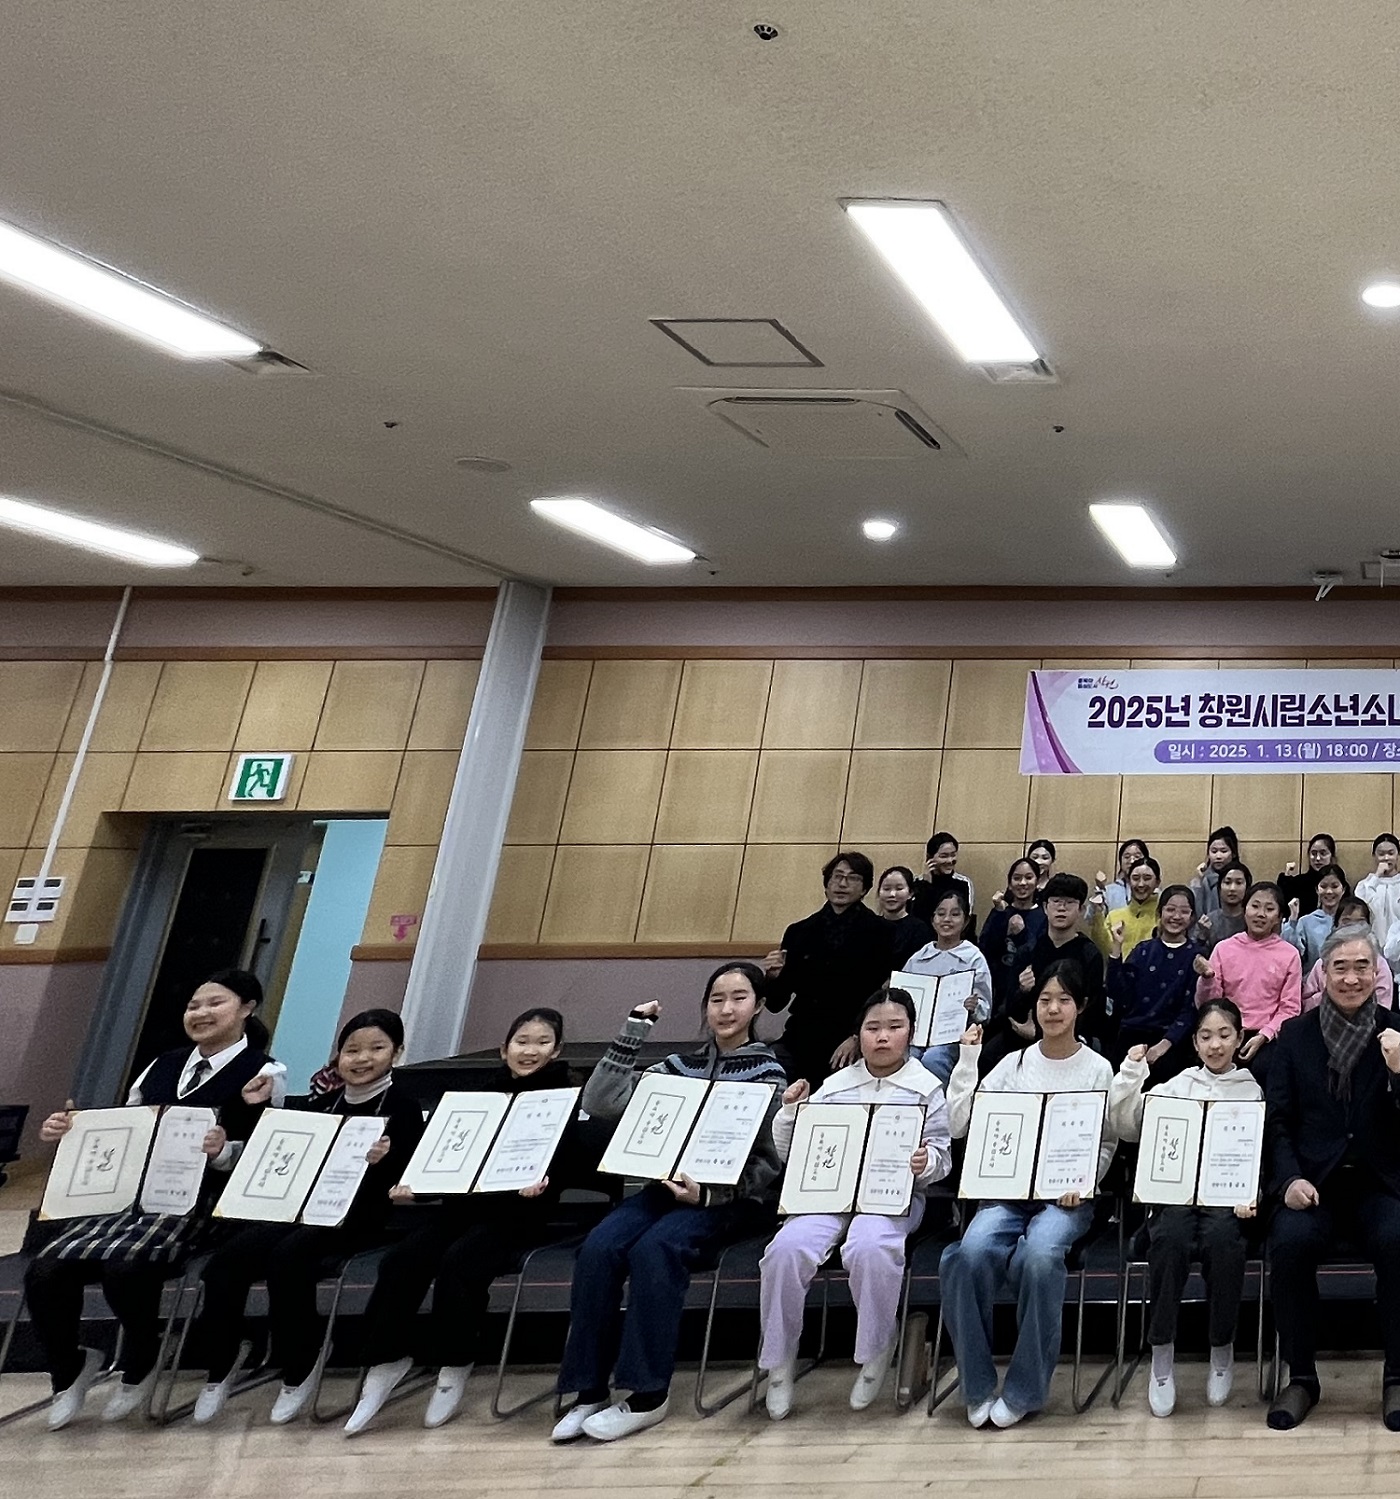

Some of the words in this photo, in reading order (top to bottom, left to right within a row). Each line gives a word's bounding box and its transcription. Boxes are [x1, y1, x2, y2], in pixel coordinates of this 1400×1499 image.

[1087, 694, 1192, 729] 2025년
[1168, 743, 1195, 760] 일시
[1209, 743, 1251, 758] 2025.
[1326, 743, 1368, 758] 18:00
